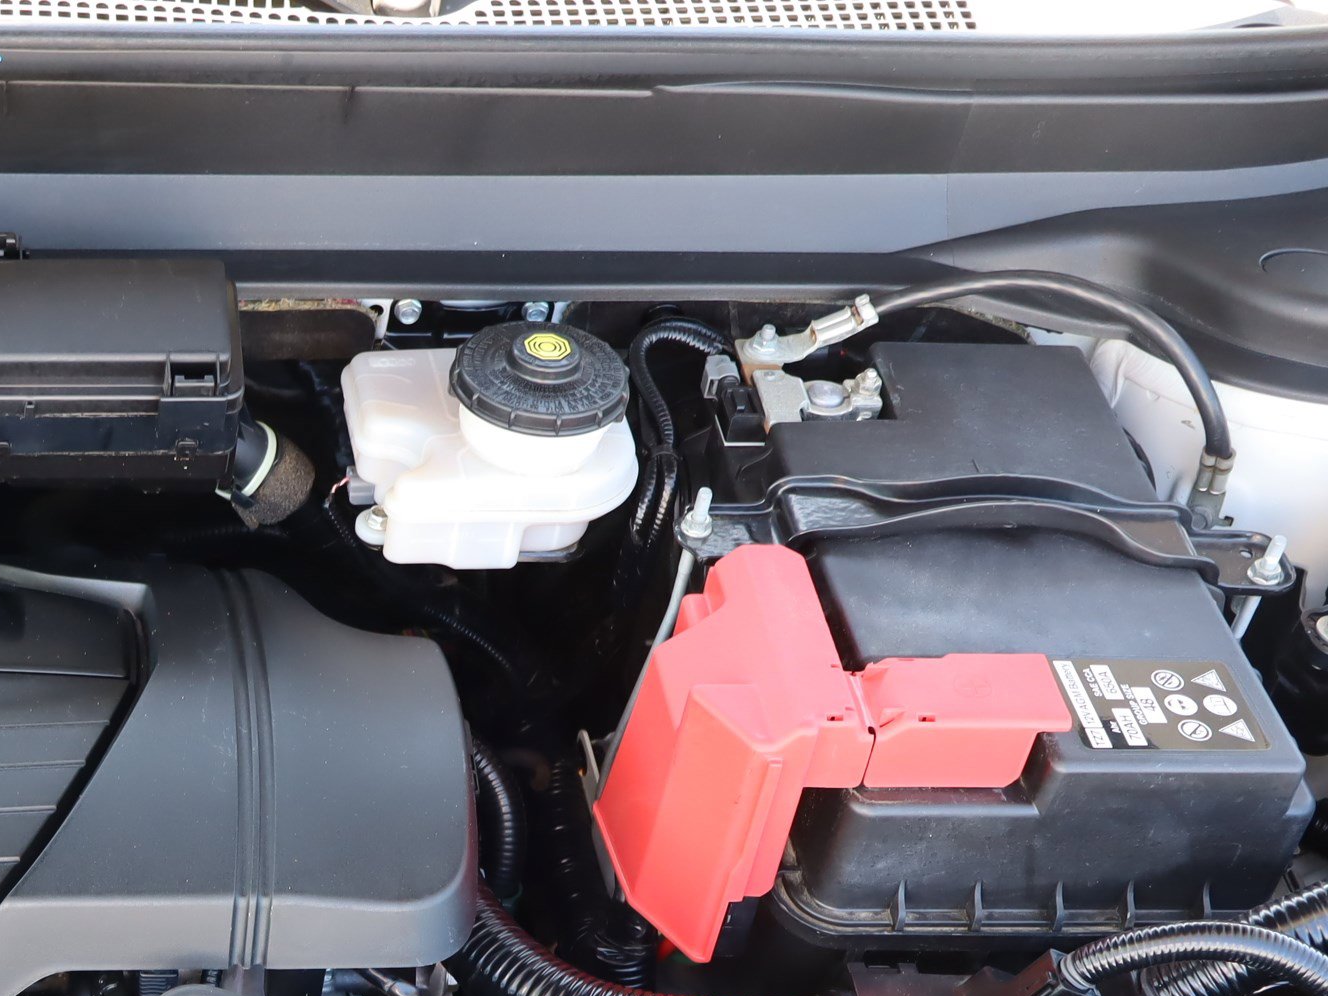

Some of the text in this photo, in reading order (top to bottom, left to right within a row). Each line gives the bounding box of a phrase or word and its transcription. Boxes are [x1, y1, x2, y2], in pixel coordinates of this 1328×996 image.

[1083, 668, 1102, 697] SAE CCA
[1060, 663, 1106, 746] TZ7 12V AGM Battery
[1120, 684, 1148, 725] GROUP SIZE
[1139, 698, 1156, 712] 48
[1119, 715, 1142, 740] 70AH
